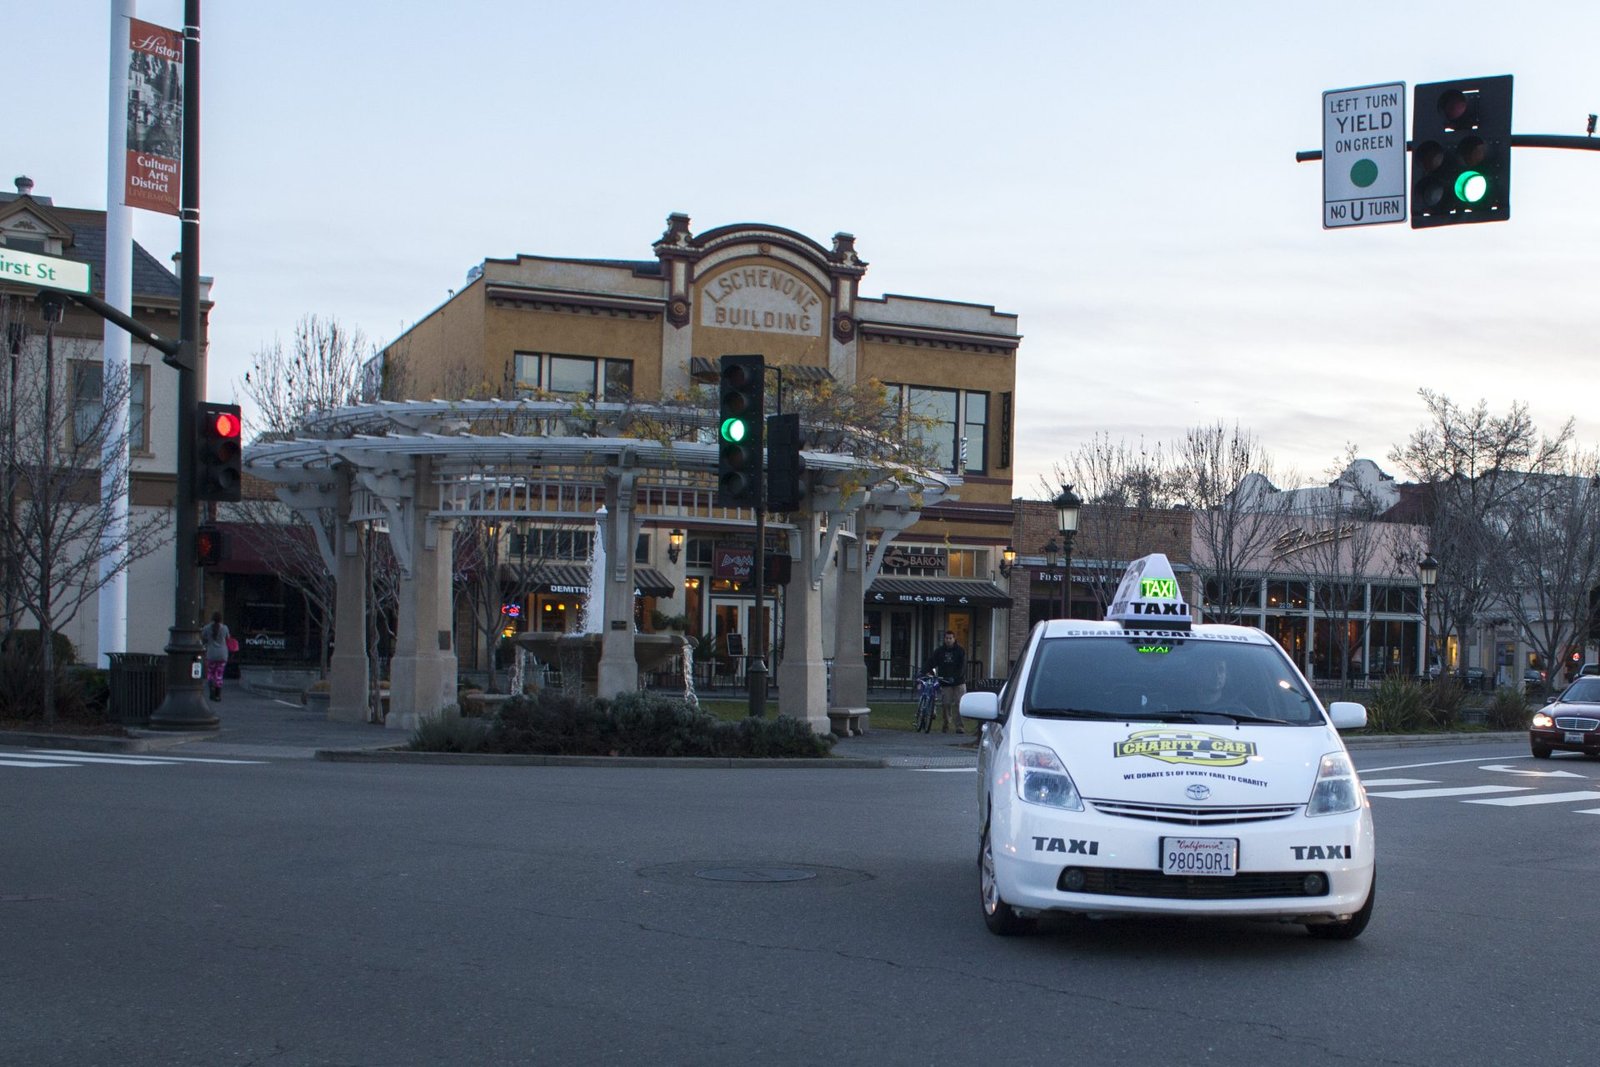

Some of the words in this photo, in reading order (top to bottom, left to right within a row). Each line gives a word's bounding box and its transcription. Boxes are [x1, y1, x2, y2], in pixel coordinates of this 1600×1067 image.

[1330, 97, 1359, 113] LEFT
[1366, 92, 1398, 109] TURN
[1336, 111, 1393, 134] YIELD
[1335, 139, 1352, 153] ON
[1353, 135, 1393, 151] GREEN
[137, 155, 176, 173] Cultural
[131, 175, 169, 193] District
[148, 170, 169, 182] Arts
[1330, 205, 1347, 219] NO
[1351, 200, 1364, 222] U
[1367, 200, 1399, 216] TURN
[0, 254, 32, 276] irst
[36, 263, 57, 281] St
[715, 306, 812, 332] BUILDING
[909, 556, 944, 567] BARON
[1070, 574, 1096, 583] TREET
[1141, 580, 1175, 598] TAXI
[1130, 602, 1187, 616] TAXI
[1122, 739, 1202, 755] CHARITY
[1211, 740, 1247, 753] CAB
[1136, 771, 1164, 779] DONATE
[1209, 771, 1226, 780] FARE
[1227, 774, 1237, 782] TO
[1237, 776, 1268, 788] CHARITY
[1032, 836, 1099, 856] TAXI
[1179, 840, 1221, 852] California
[1289, 845, 1352, 861] TAXI
[1168, 852, 1231, 870] 98050R1
